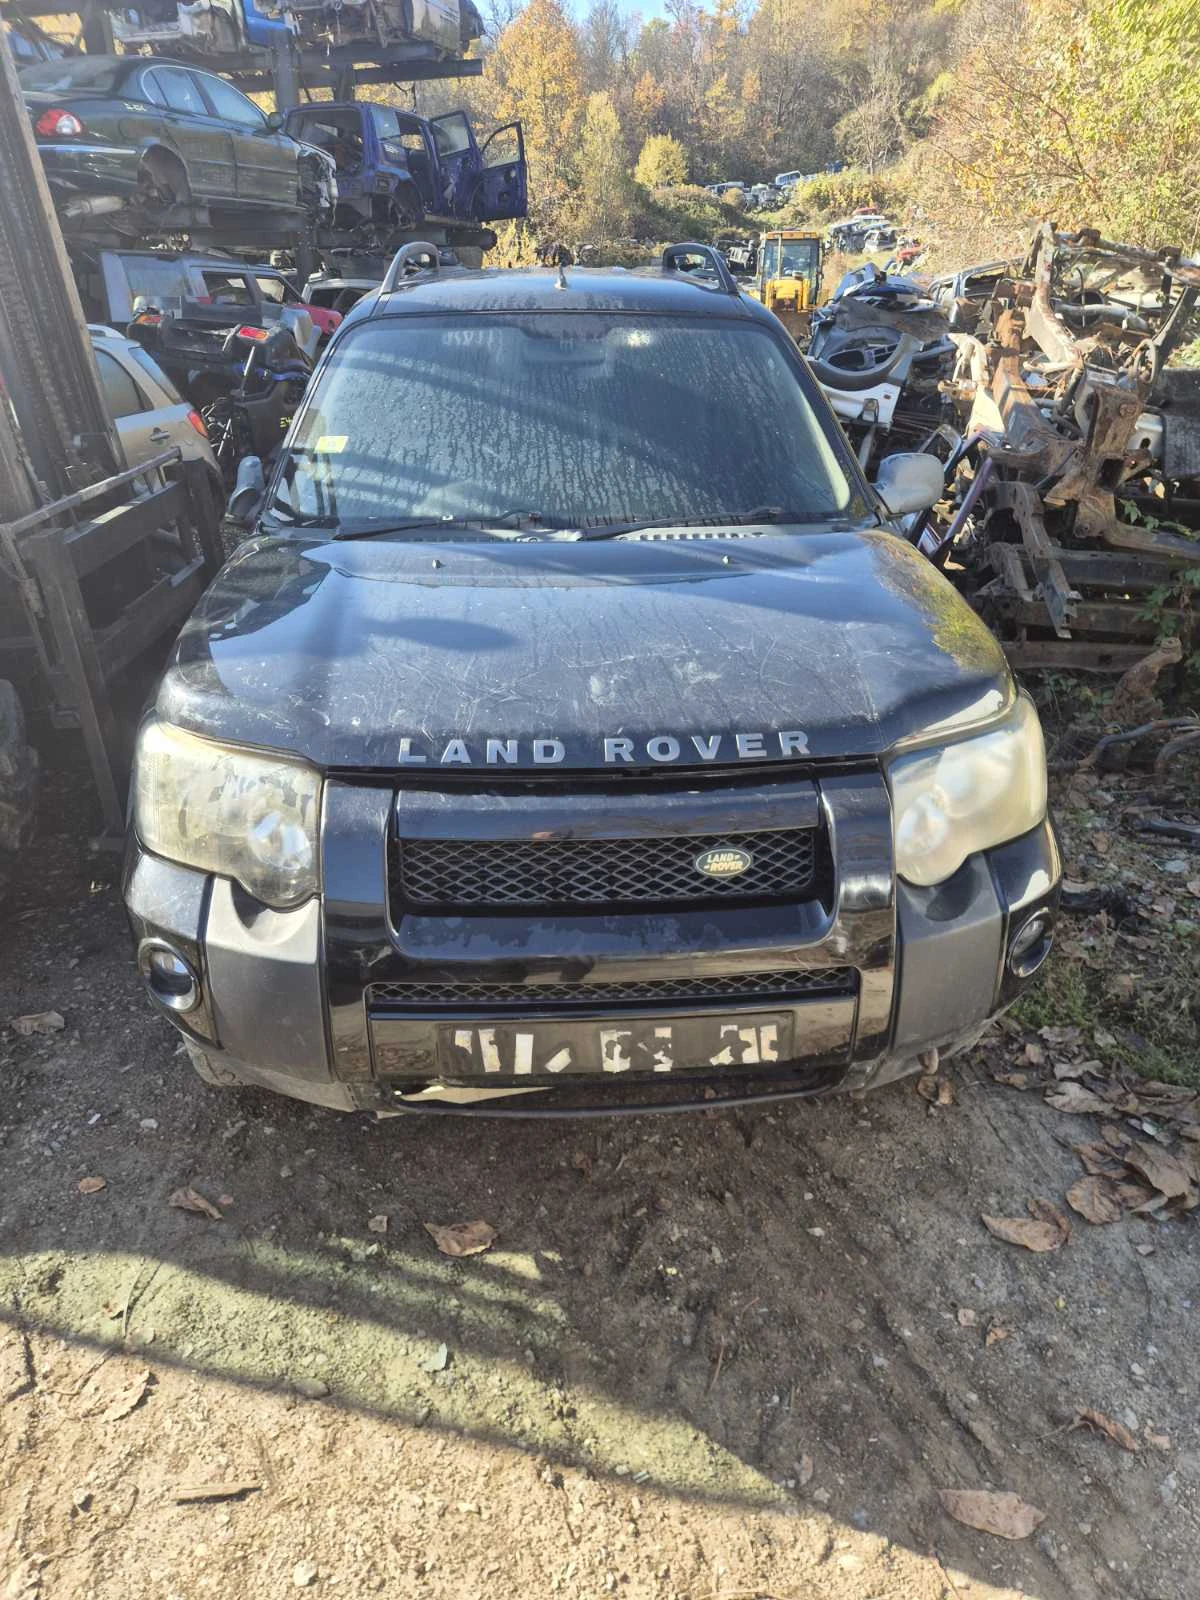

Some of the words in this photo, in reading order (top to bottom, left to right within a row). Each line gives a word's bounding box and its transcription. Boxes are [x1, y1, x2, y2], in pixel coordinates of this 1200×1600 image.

[399, 738, 566, 764] LAND
[603, 731, 811, 763] ROVER
[707, 853, 735, 863] LAND
[709, 861, 743, 872] ROVER
